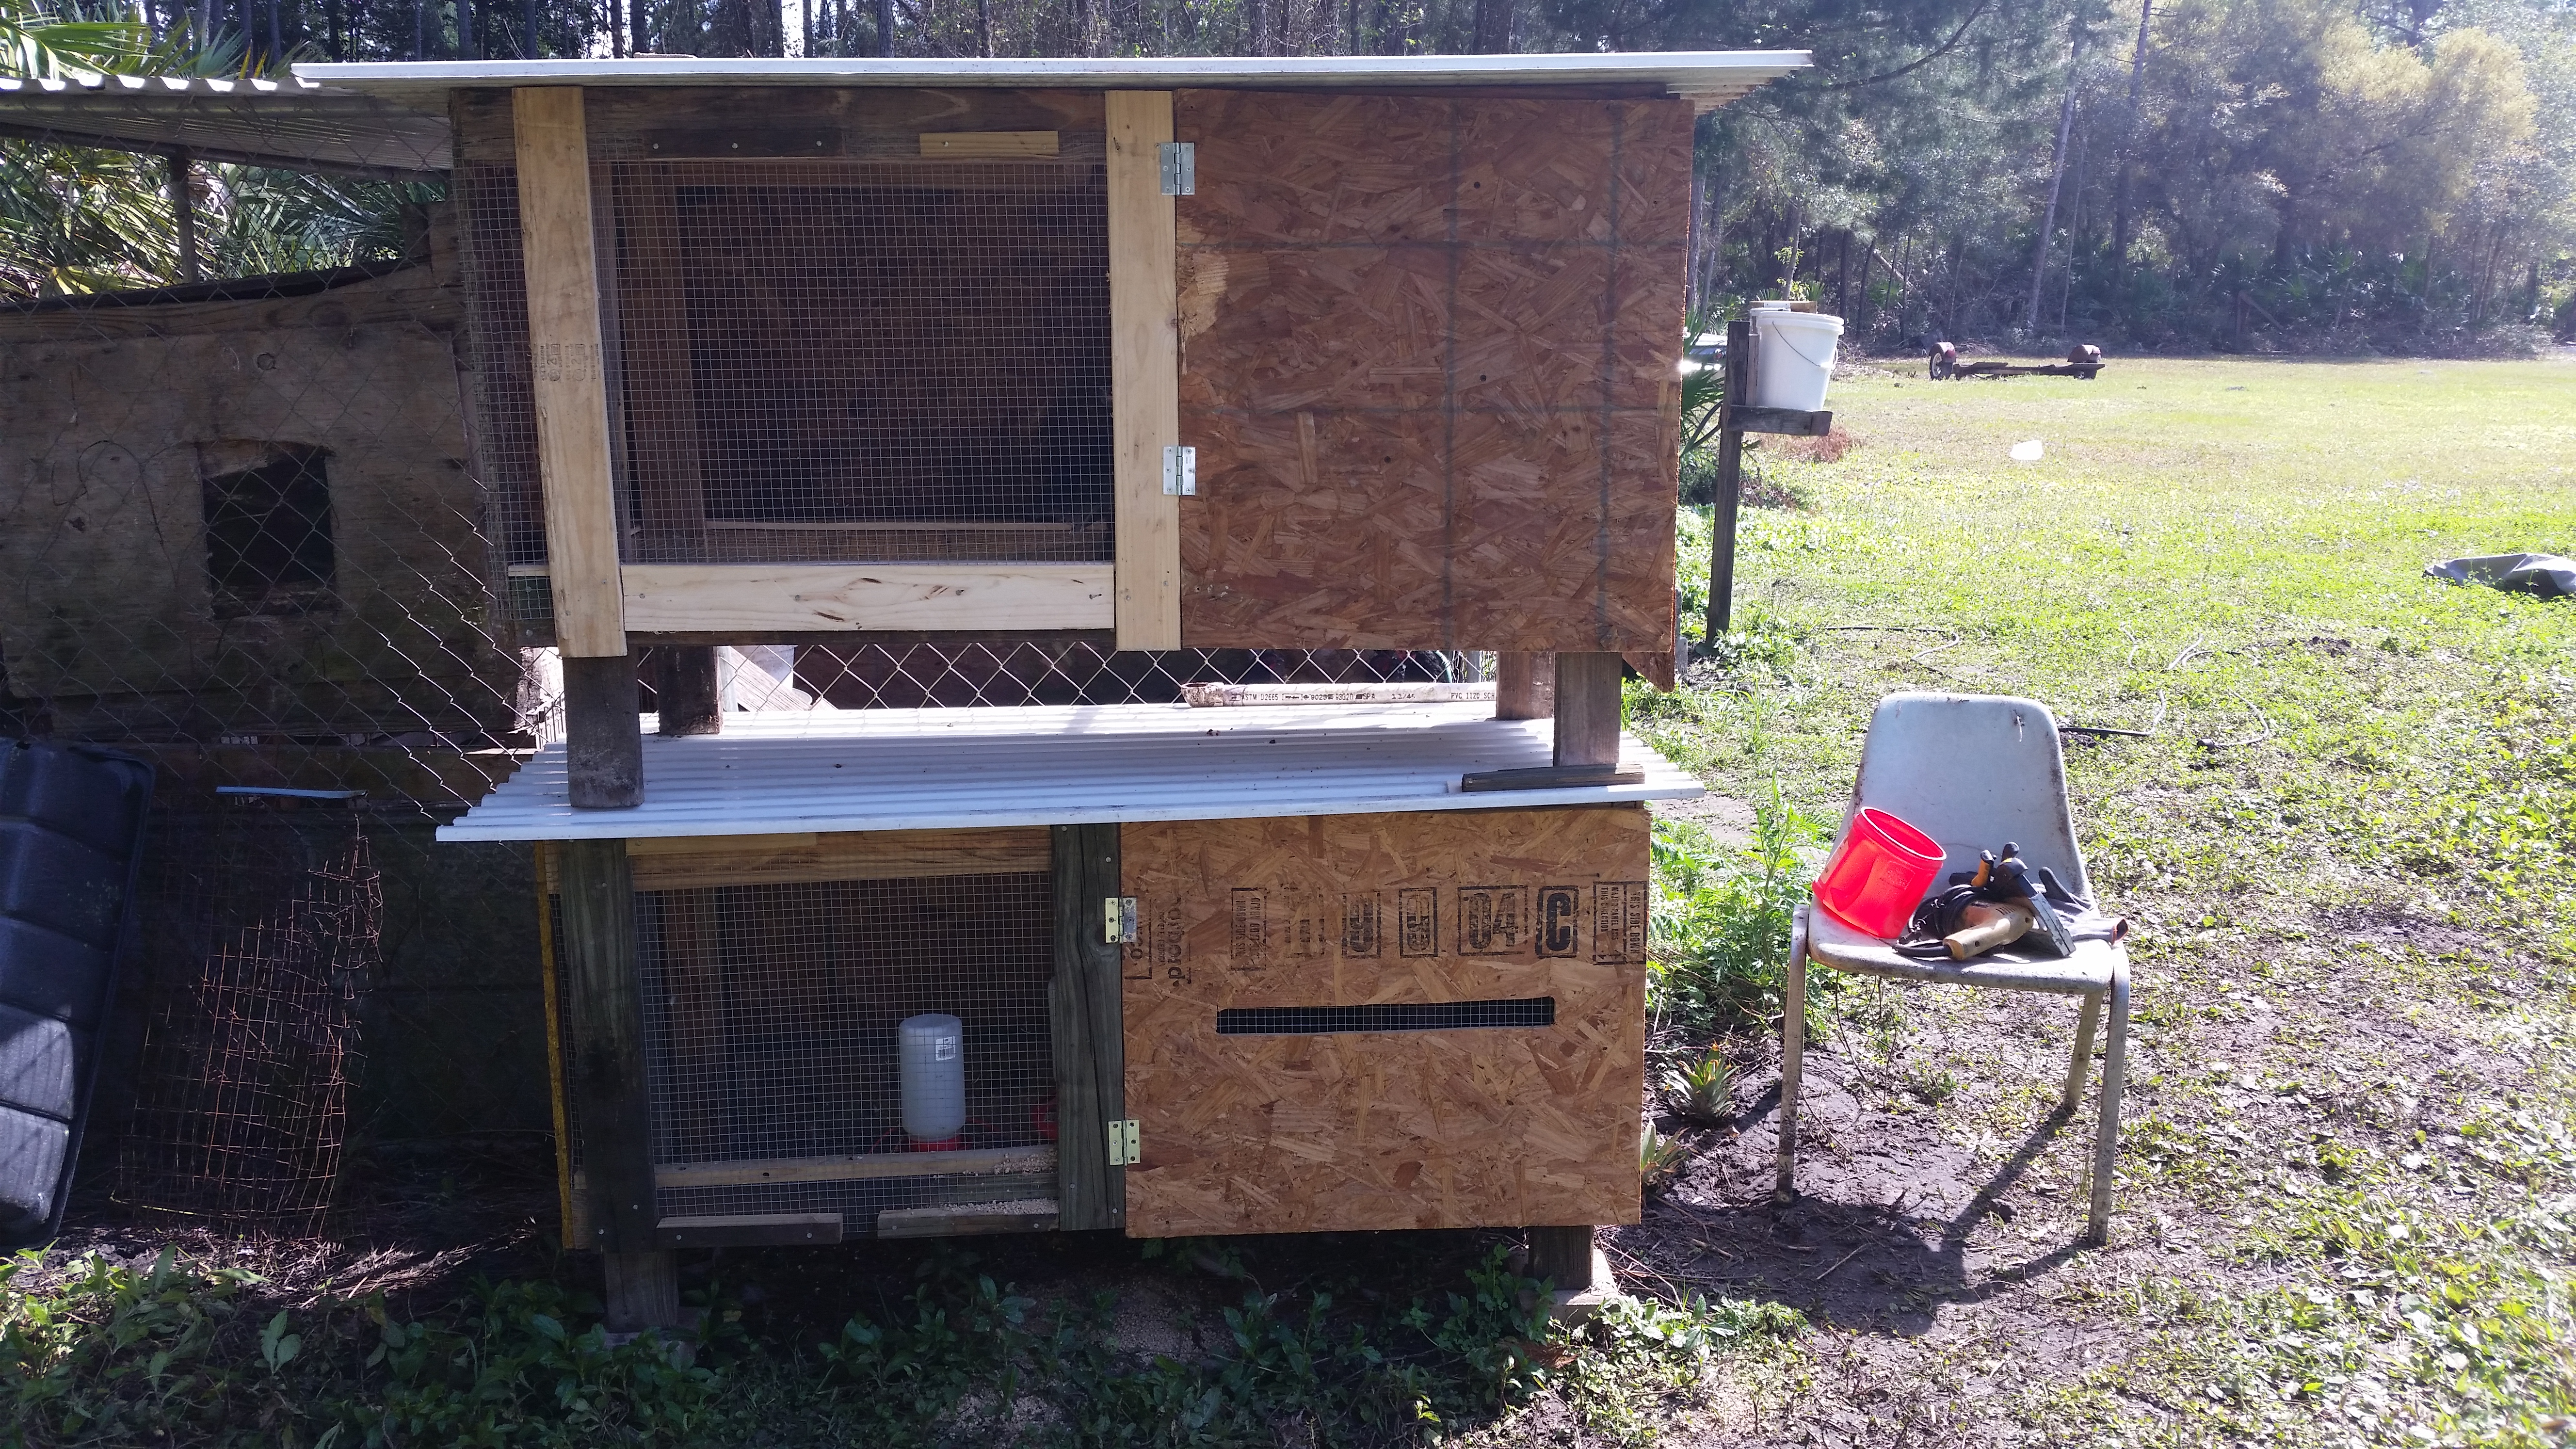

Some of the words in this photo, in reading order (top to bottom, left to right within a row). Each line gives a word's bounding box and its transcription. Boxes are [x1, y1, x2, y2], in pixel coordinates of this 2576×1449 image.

[1630, 892, 1640, 909] THIS
[1235, 901, 1246, 921] DOWN
[1611, 908, 1619, 926] PANEL
[1469, 893, 1518, 949] 04
[1546, 893, 1571, 951] C
[1630, 913, 1640, 929] SIDE
[1235, 924, 1246, 940] SIDE
[1630, 933, 1641, 954] DOWN
